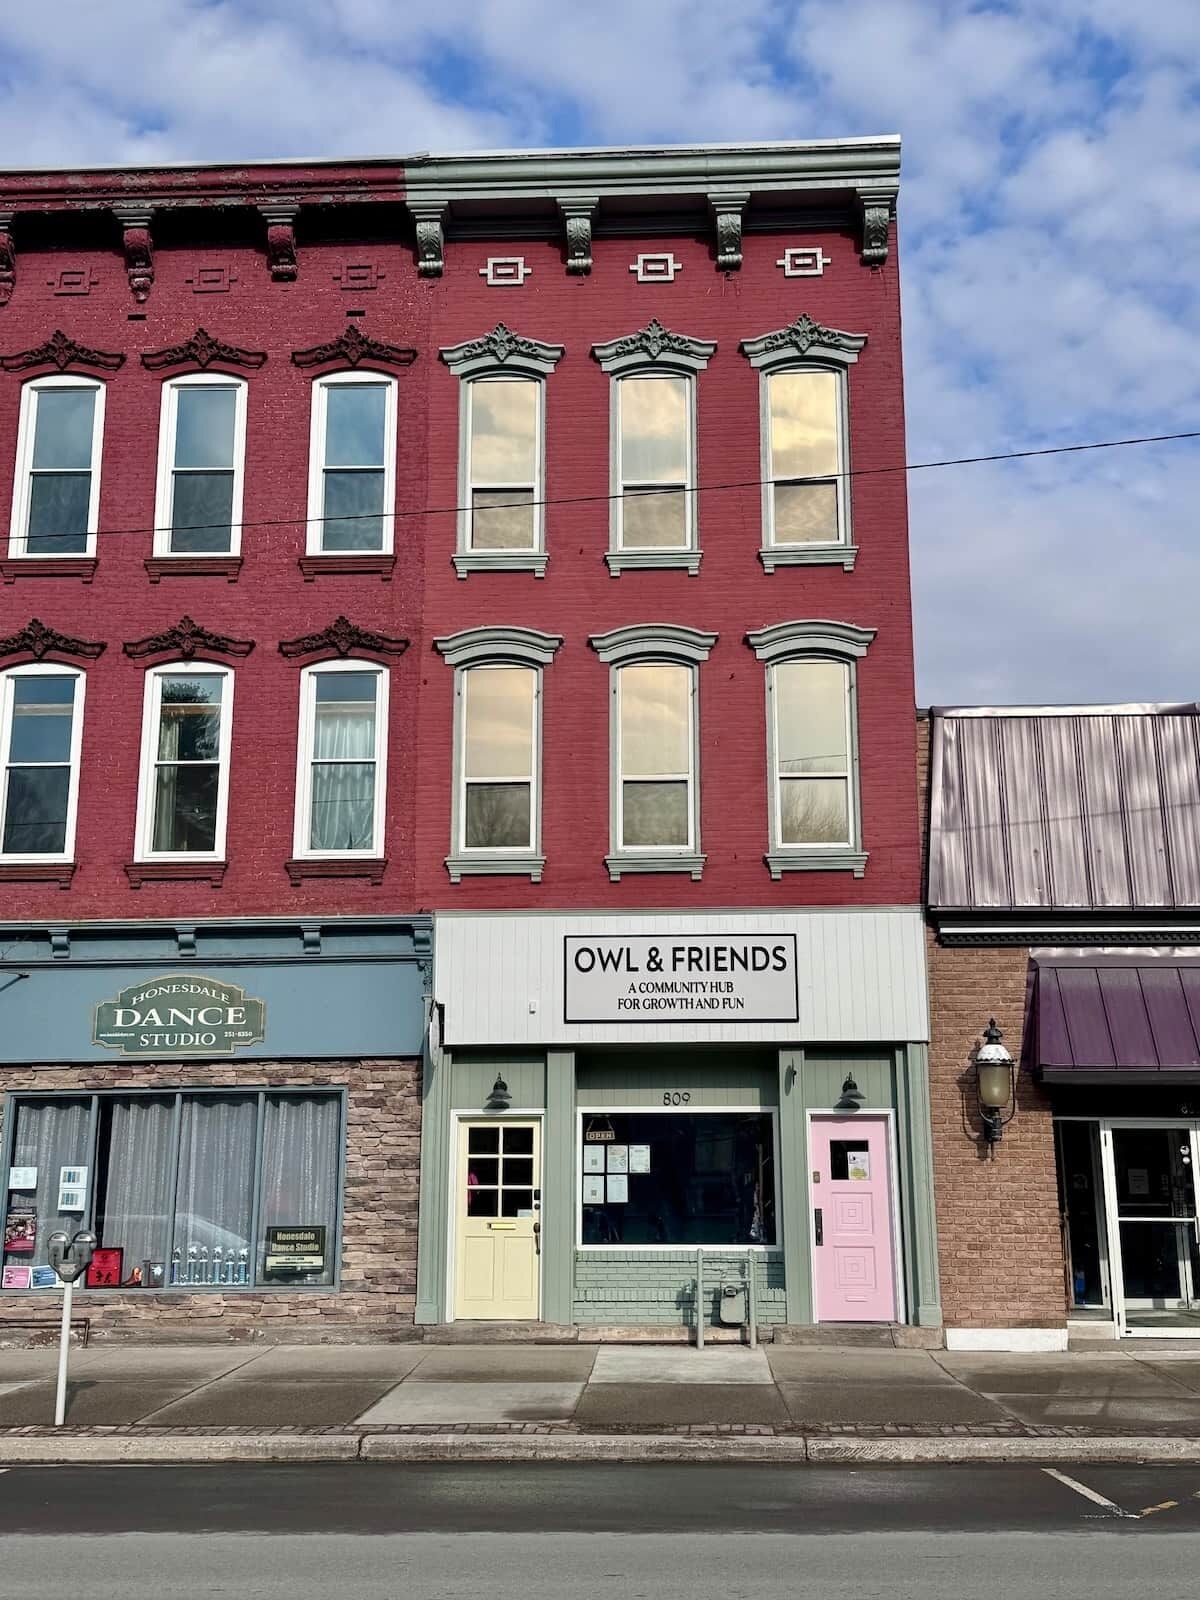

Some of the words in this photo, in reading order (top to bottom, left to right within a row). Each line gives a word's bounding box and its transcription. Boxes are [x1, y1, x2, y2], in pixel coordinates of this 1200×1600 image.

[575, 947, 639, 973] OWL
[647, 946, 664, 972] &
[672, 945, 787, 972] FRIENDS
[628, 982, 636, 993] A
[639, 982, 708, 993] COMMUNITY
[710, 981, 734, 993] HUB
[131, 984, 231, 1005] HONESDALE
[618, 998, 640, 1010] FOR
[642, 998, 694, 1010] GROWTH
[695, 997, 720, 1010] AND
[722, 997, 745, 1010] FUN
[114, 1007, 246, 1027] DANCE
[140, 1032, 216, 1046] STUDIO
[663, 1092, 691, 1106] 809
[588, 1131, 613, 1139] OPEN
